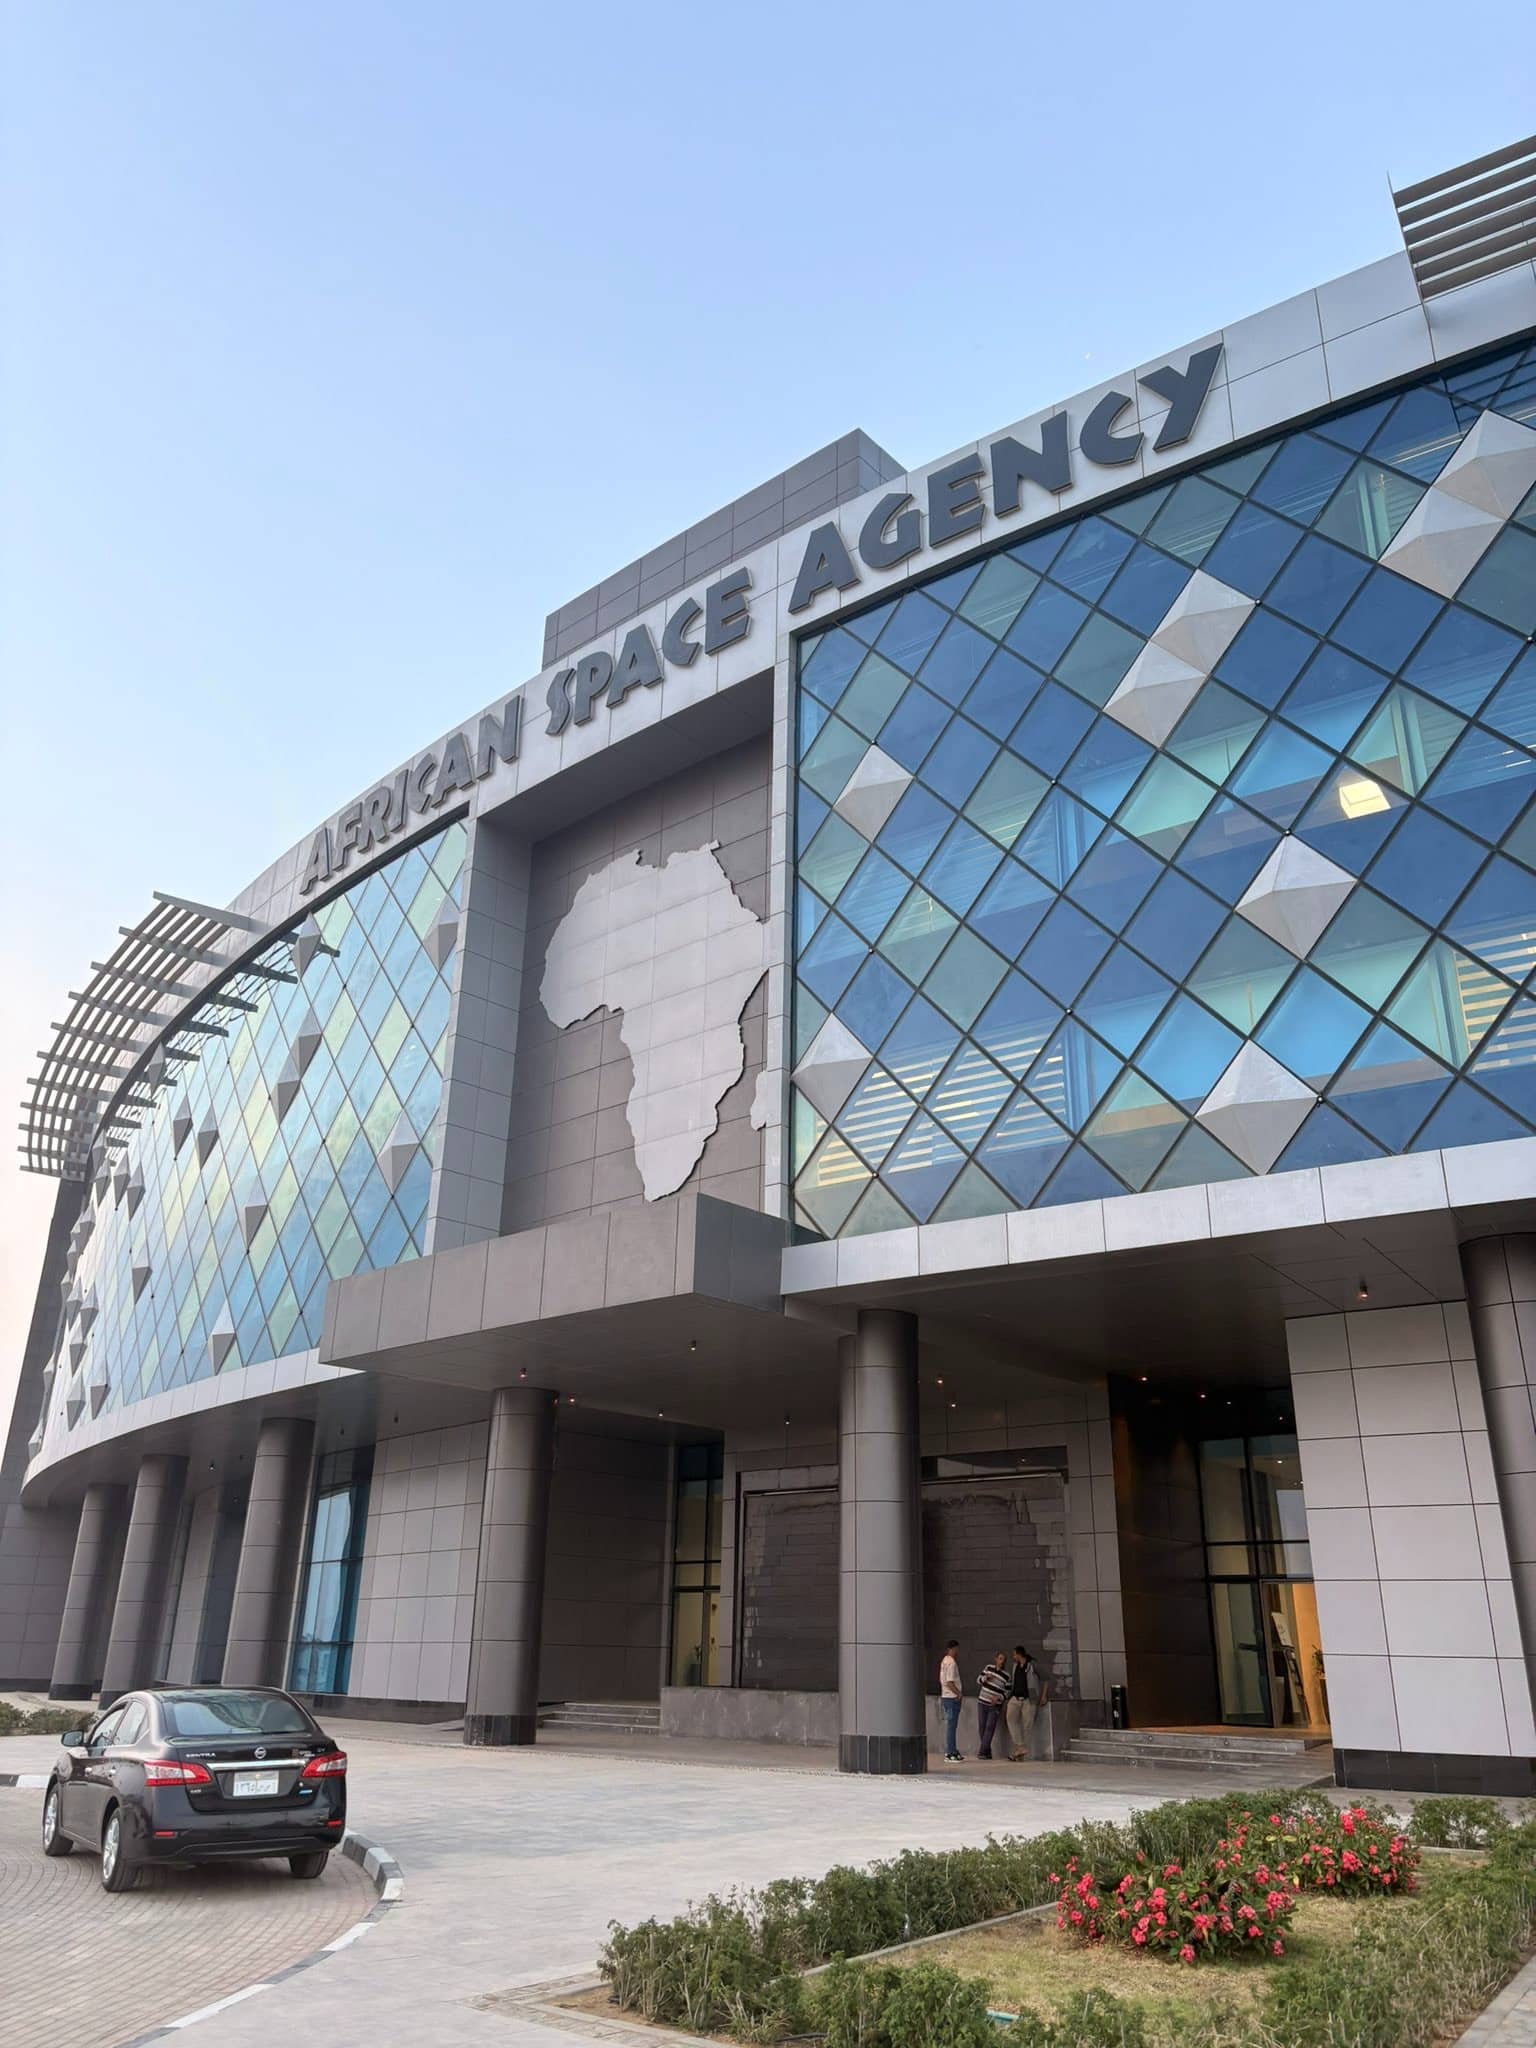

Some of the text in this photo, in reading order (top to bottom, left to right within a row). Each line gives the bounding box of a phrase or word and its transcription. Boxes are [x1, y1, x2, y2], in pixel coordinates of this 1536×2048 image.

[299, 343, 1224, 895] AFRICAN SPACE AGENCY
